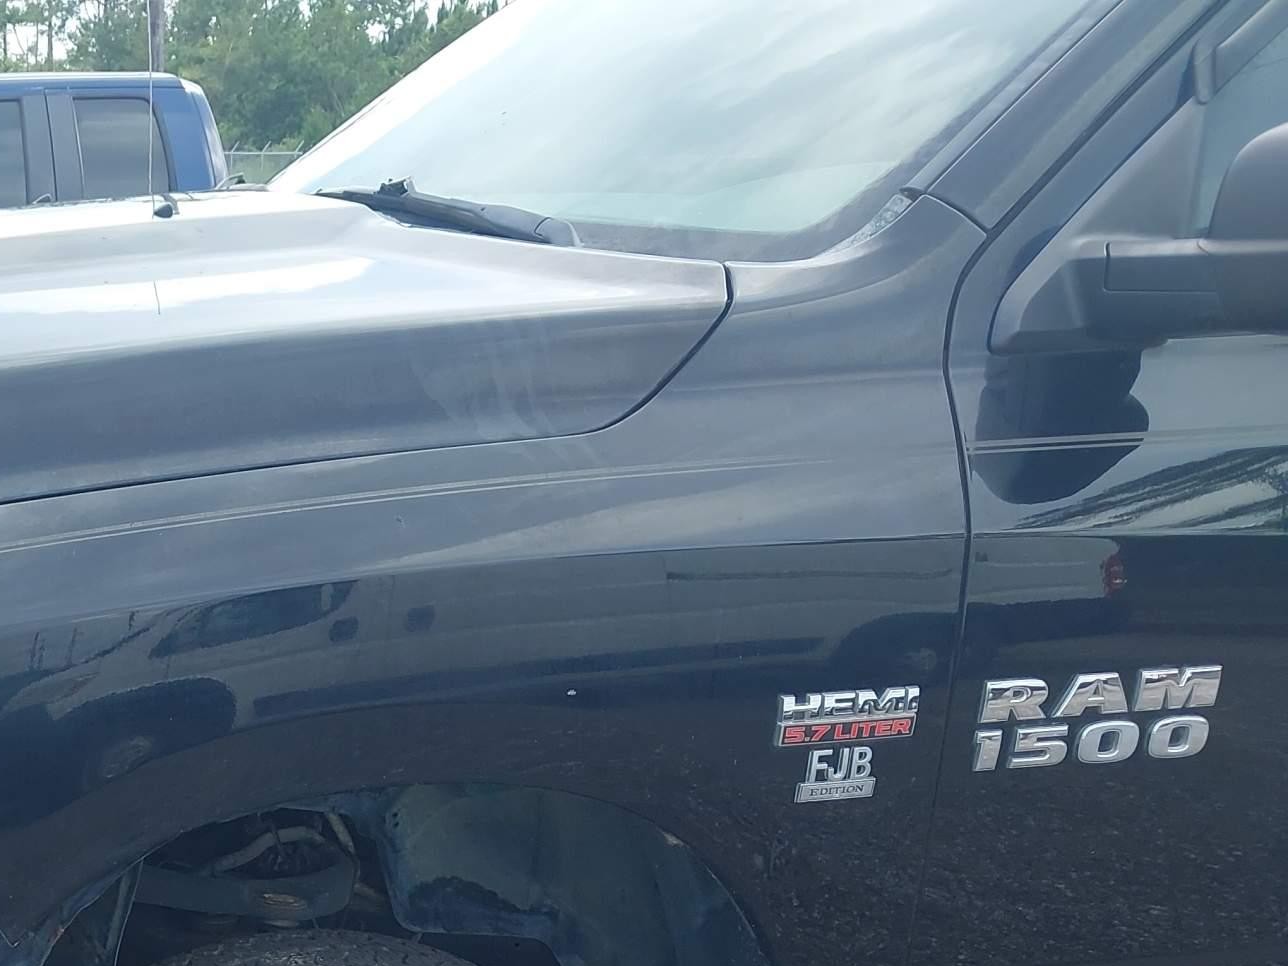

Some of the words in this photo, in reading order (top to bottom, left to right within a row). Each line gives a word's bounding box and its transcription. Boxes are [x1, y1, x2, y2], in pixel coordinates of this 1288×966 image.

[779, 686, 920, 721] HEMI
[978, 665, 1223, 723] RAM
[783, 725, 831, 743] 5.7
[834, 719, 912, 739] LITER
[973, 715, 1210, 772] 1500
[806, 746, 873, 784] FJB
[809, 785, 865, 796] EDITION
